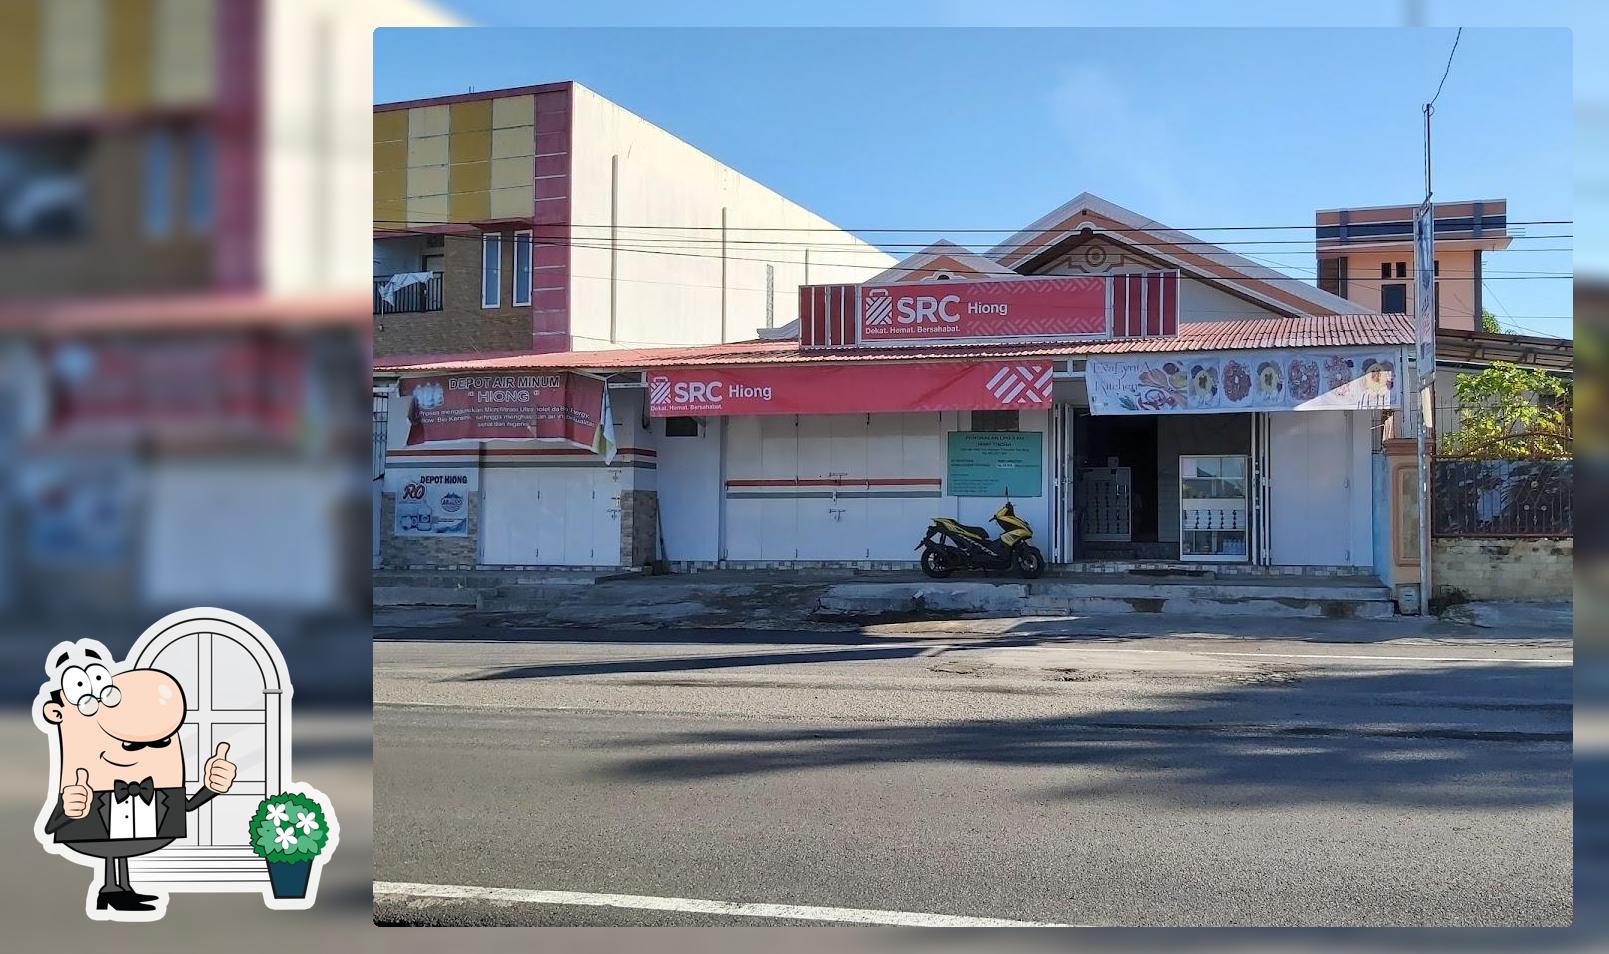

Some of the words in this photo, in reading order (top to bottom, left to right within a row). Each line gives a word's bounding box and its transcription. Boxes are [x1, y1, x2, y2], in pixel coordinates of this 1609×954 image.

[897, 295, 961, 324] SRC
[968, 302, 1008, 315] Hiong
[890, 326, 916, 334] Hemat.
[917, 325, 961, 333] Bersahabat.
[448, 377, 493, 390] DEPOT
[492, 376, 516, 388] AIR
[517, 375, 561, 388] MINUM
[674, 381, 723, 403] SRC
[729, 384, 772, 401] Hiong
[420, 475, 444, 484] DEPOT
[444, 475, 468, 484] HIONG
